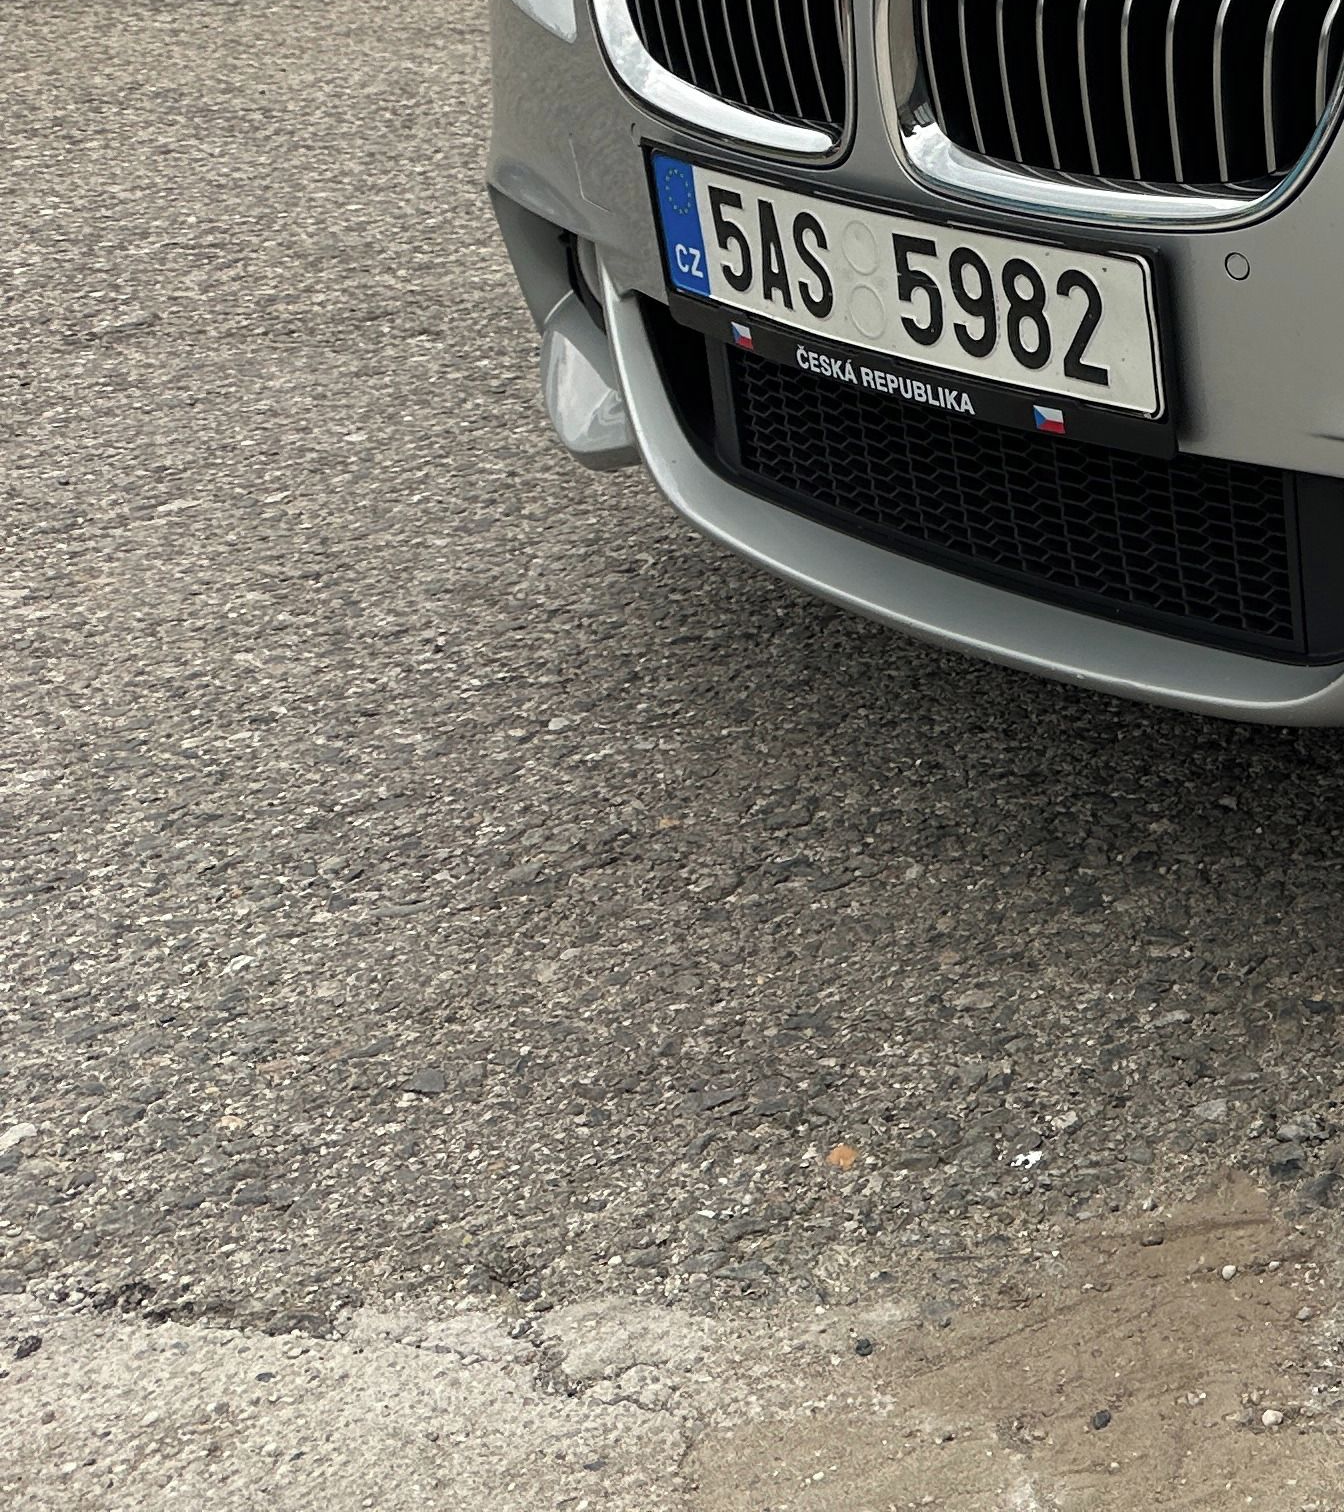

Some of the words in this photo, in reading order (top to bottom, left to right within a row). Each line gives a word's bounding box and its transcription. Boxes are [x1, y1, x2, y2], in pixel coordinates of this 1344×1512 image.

[675, 243, 704, 278] CZ
[707, 185, 834, 320] 5AS
[891, 233, 1109, 387] 5982
[796, 345, 859, 386] ČESKÁ
[861, 364, 975, 416] REPUBLIKA
